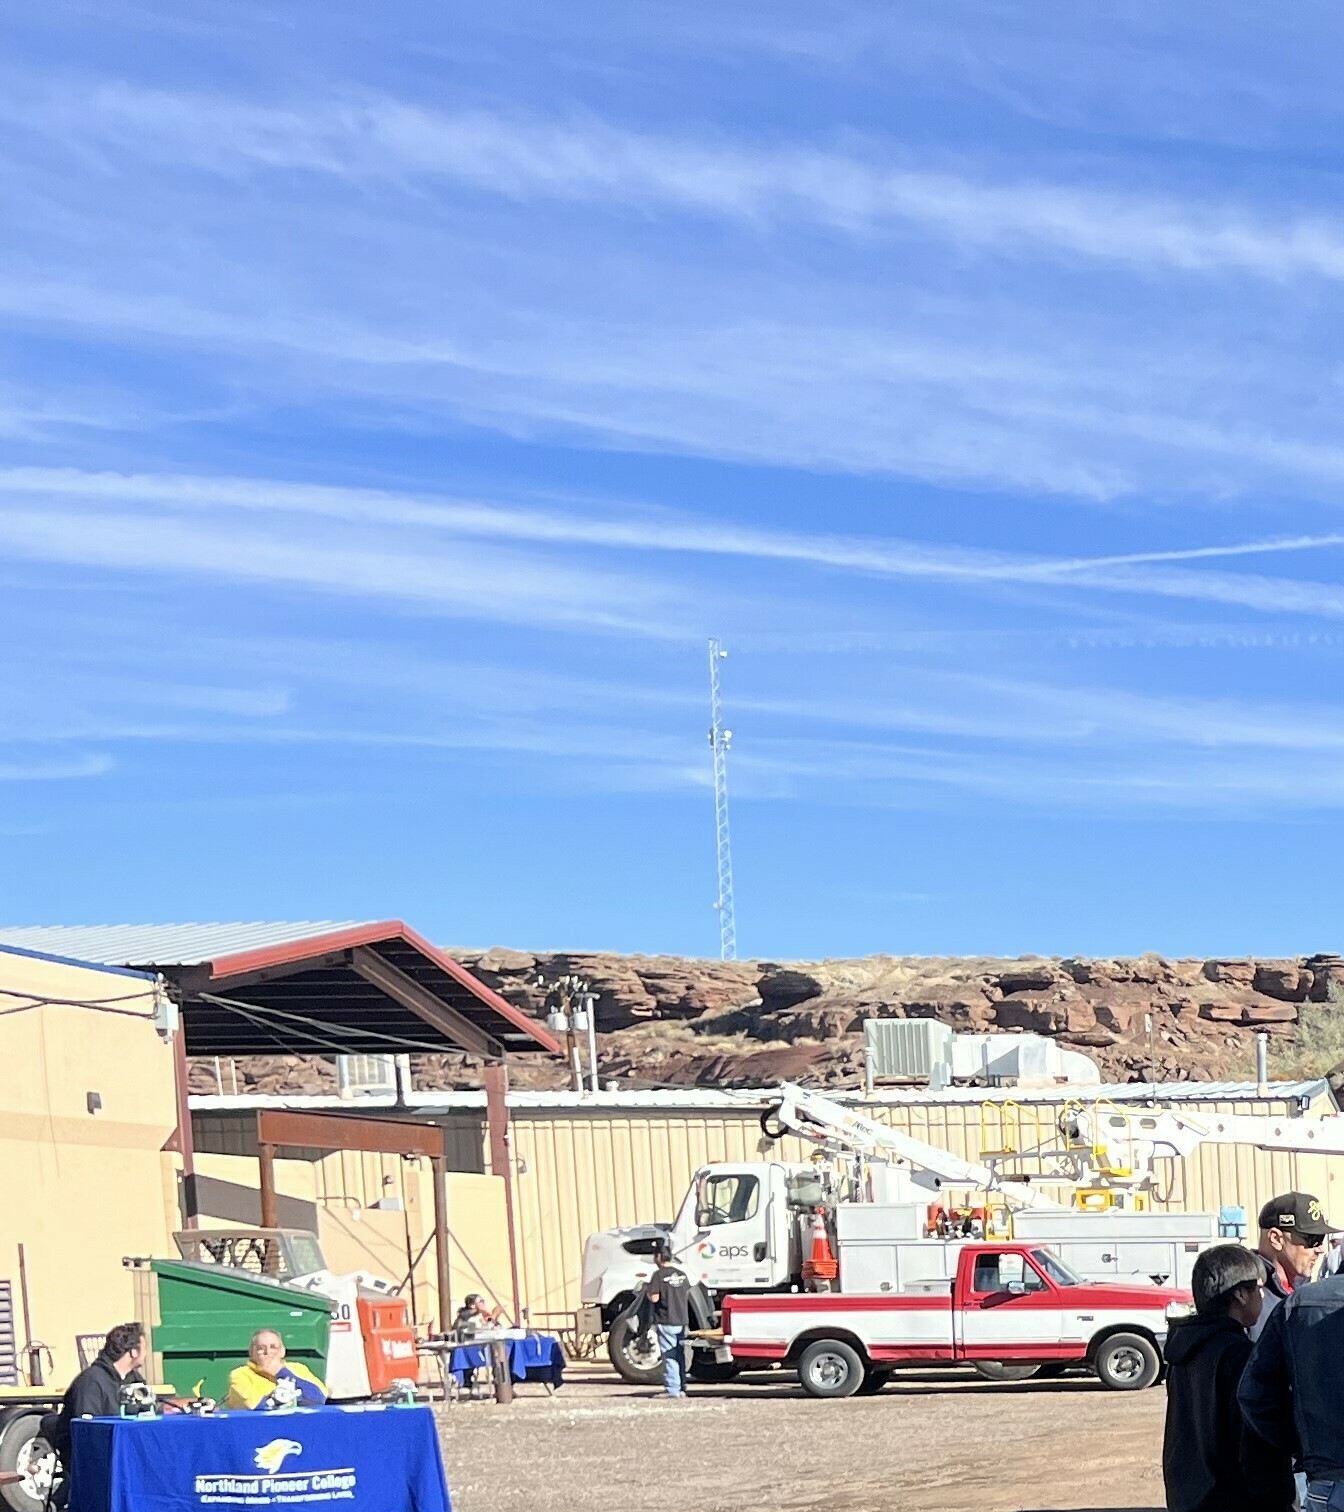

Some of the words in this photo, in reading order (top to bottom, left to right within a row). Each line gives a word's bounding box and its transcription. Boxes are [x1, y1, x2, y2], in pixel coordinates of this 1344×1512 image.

[719, 1245, 749, 1259] aps
[195, 1479, 259, 1494] Northland
[262, 1479, 309, 1493] Pioneer
[312, 1475, 356, 1490] College
